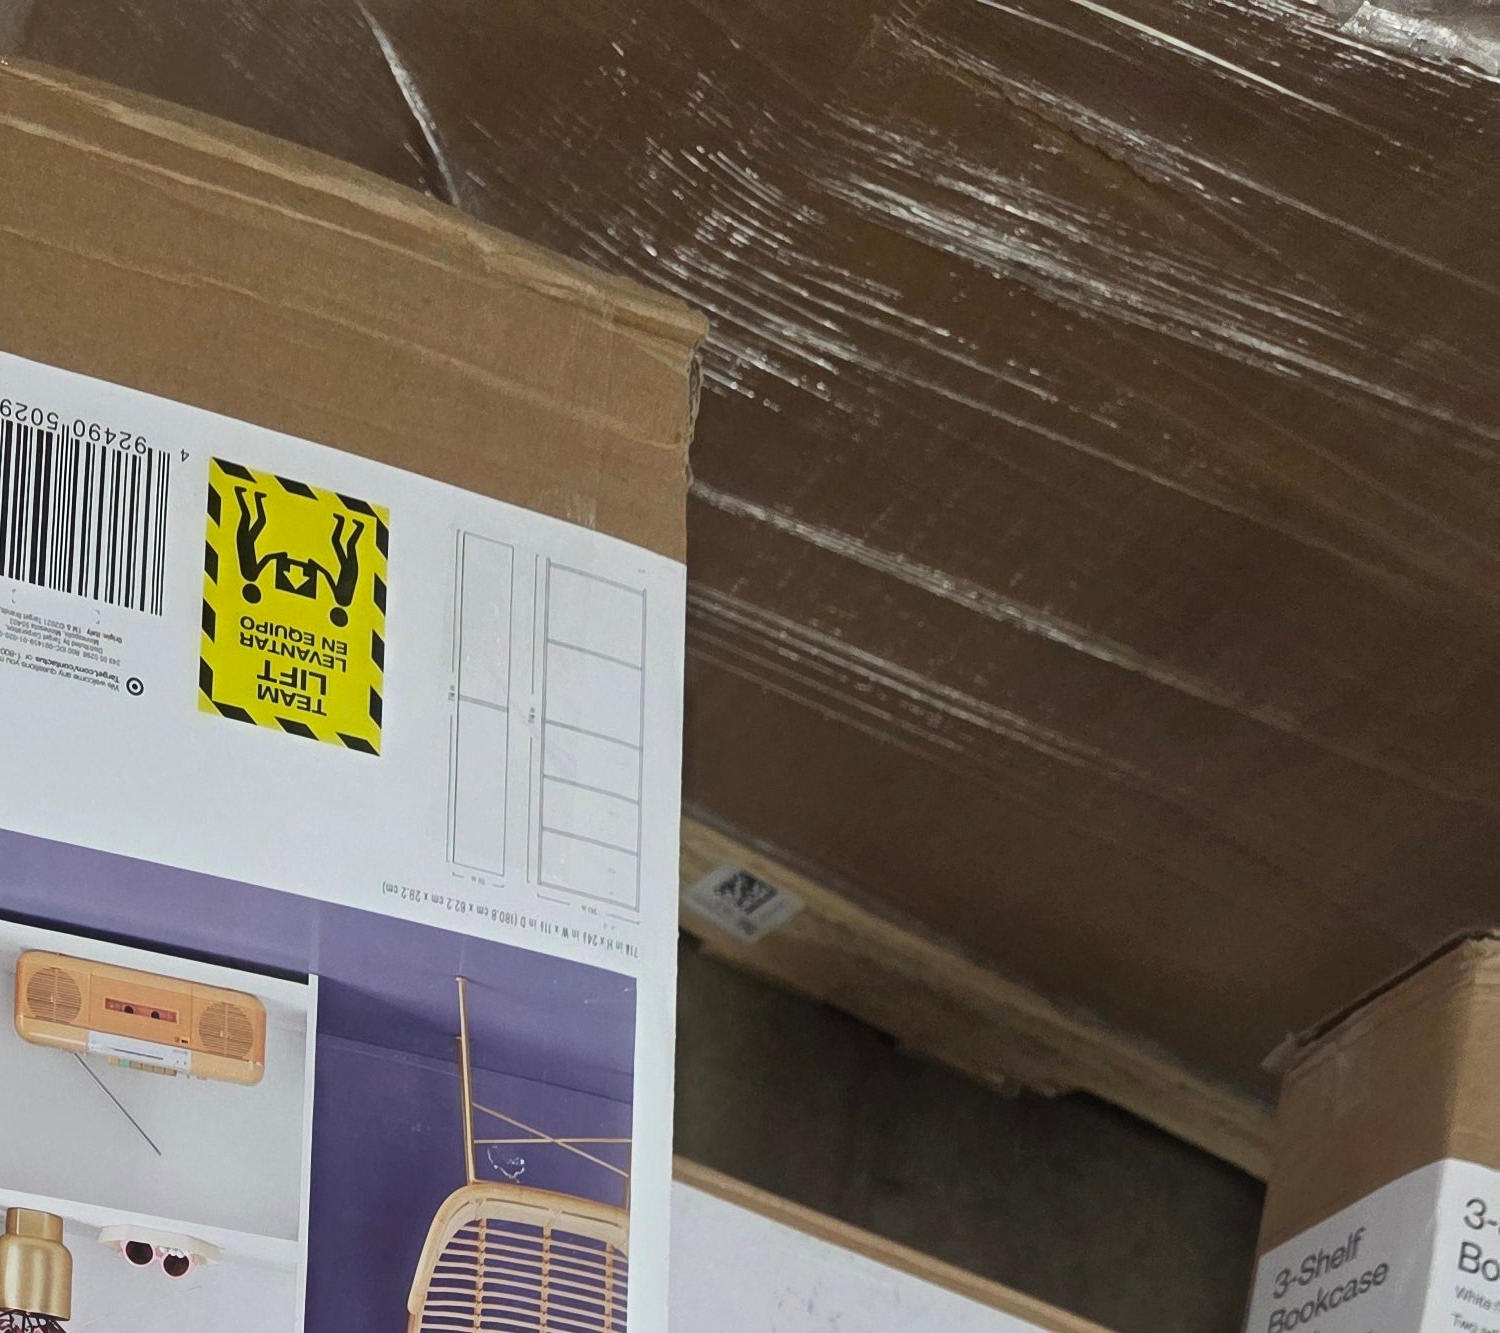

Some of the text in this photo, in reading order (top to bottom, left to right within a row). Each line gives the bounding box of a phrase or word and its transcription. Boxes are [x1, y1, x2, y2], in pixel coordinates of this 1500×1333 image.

[72, 420, 147, 454] 92490
[180, 449, 190, 463] 4
[239, 616, 349, 656] EN EQUIPO
[239, 632, 348, 673] LEVANTAR
[257, 659, 328, 696] LIFT
[257, 684, 328, 717] TEAM
[1273, 1226, 1367, 1299] 3-Shelf
